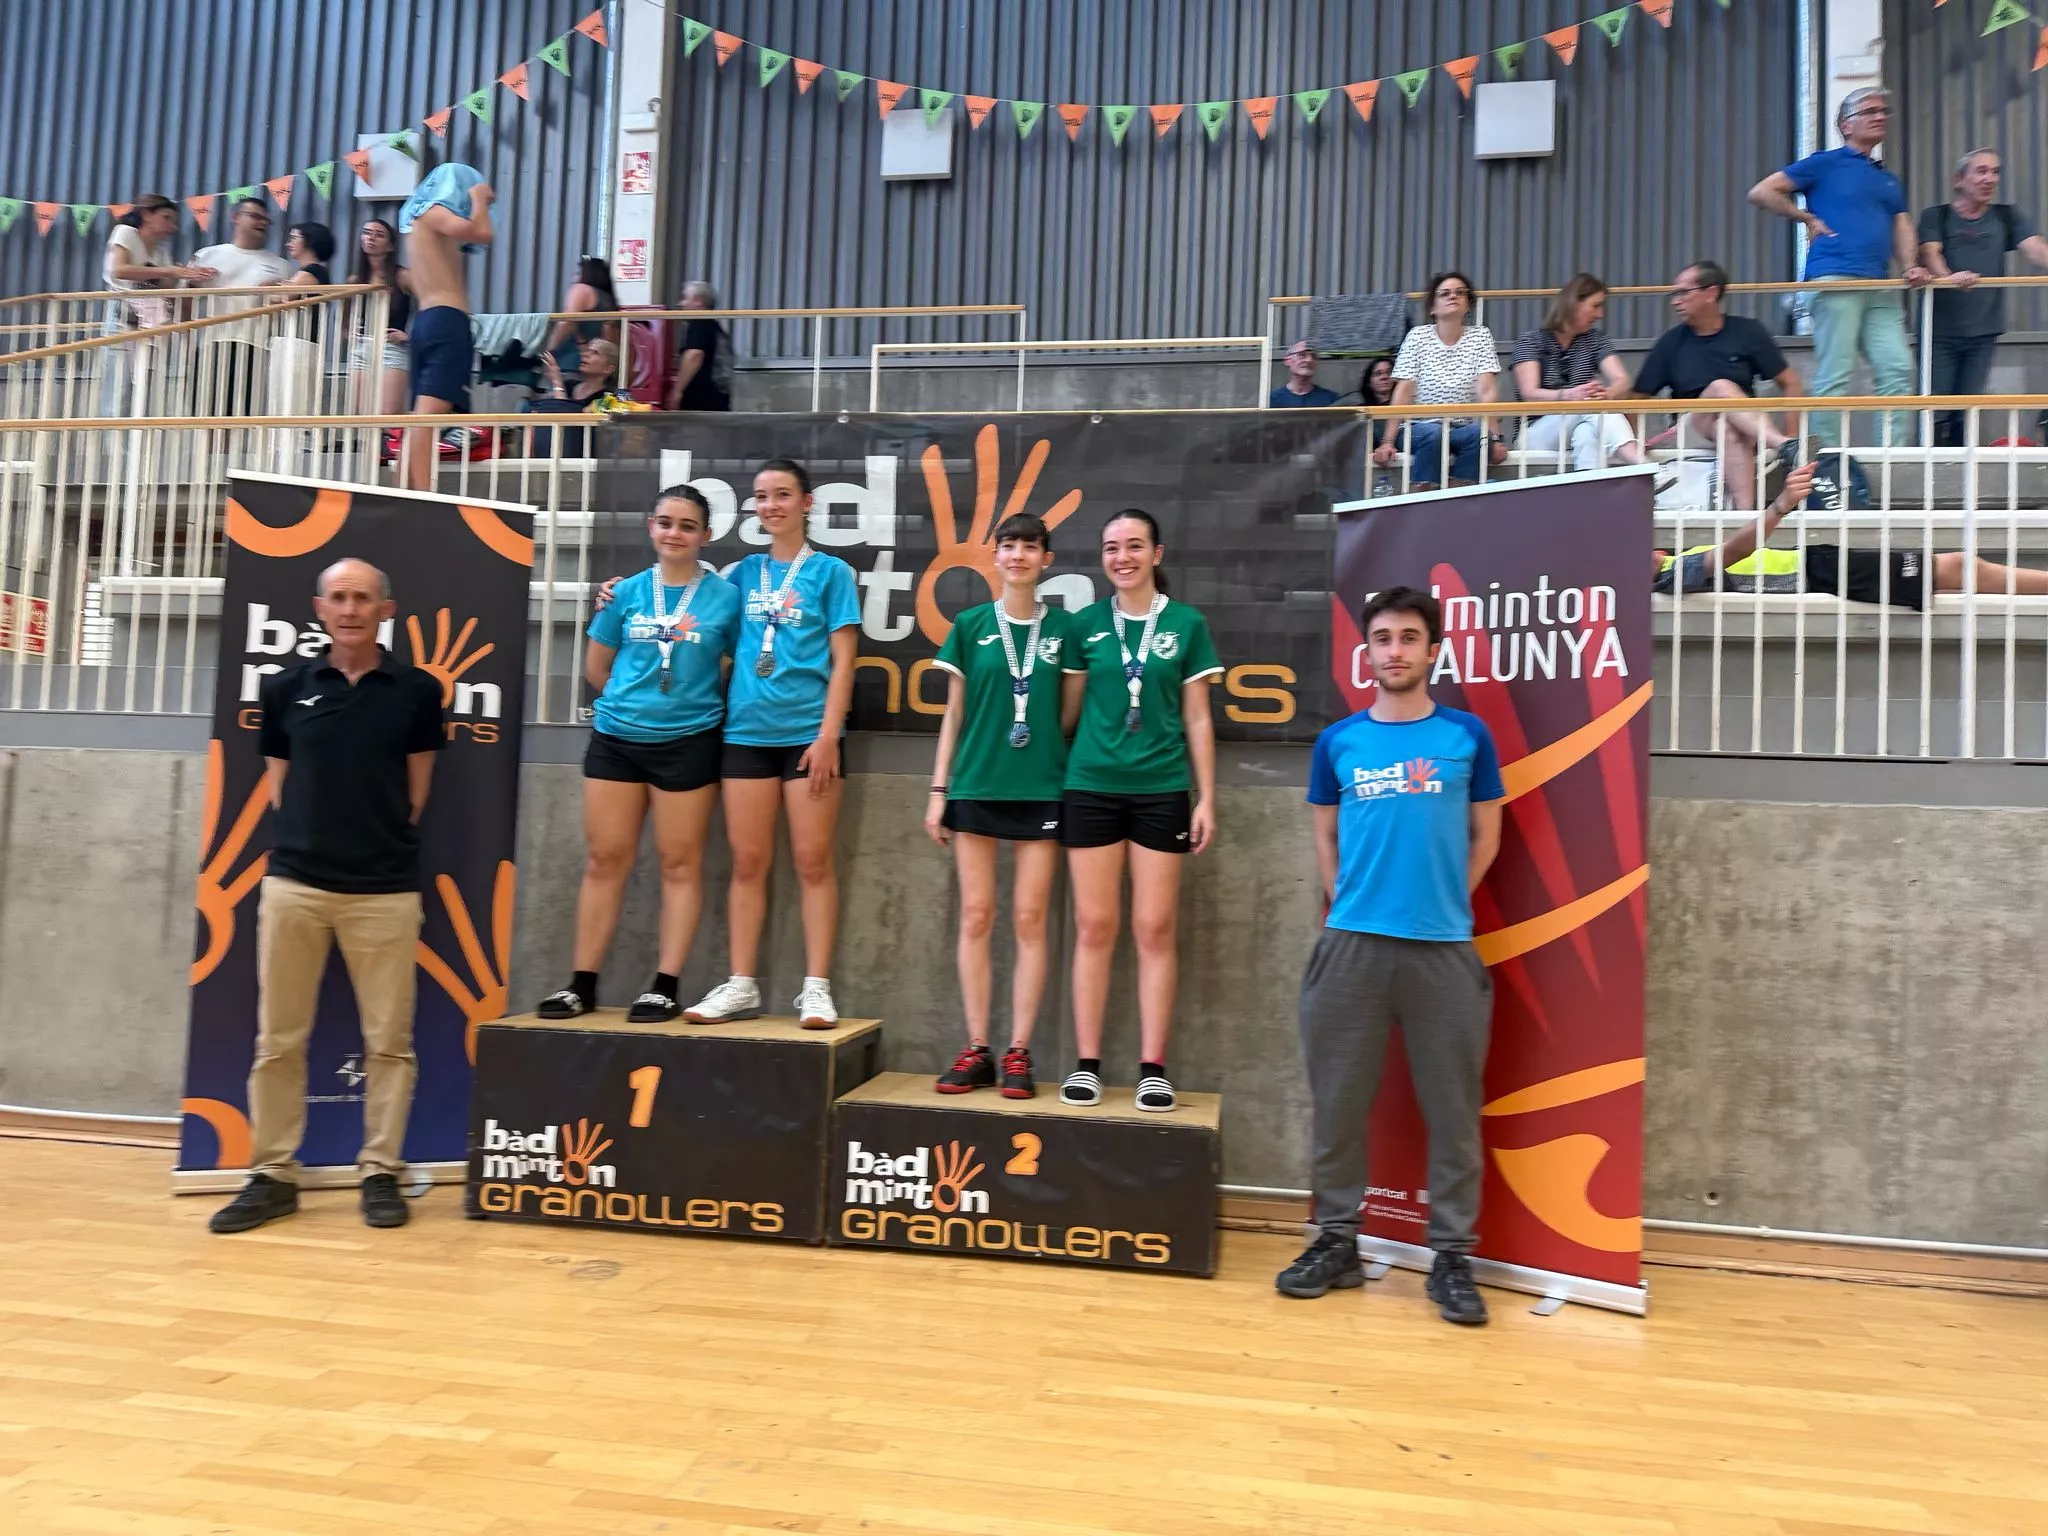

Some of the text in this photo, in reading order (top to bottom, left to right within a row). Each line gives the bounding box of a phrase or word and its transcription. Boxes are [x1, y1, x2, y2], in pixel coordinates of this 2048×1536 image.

[1365, 575, 1617, 632] minton
[1351, 626, 1629, 689] CALUNYA
[629, 1066, 662, 1127] 1
[1005, 1133, 1043, 1175] 2
